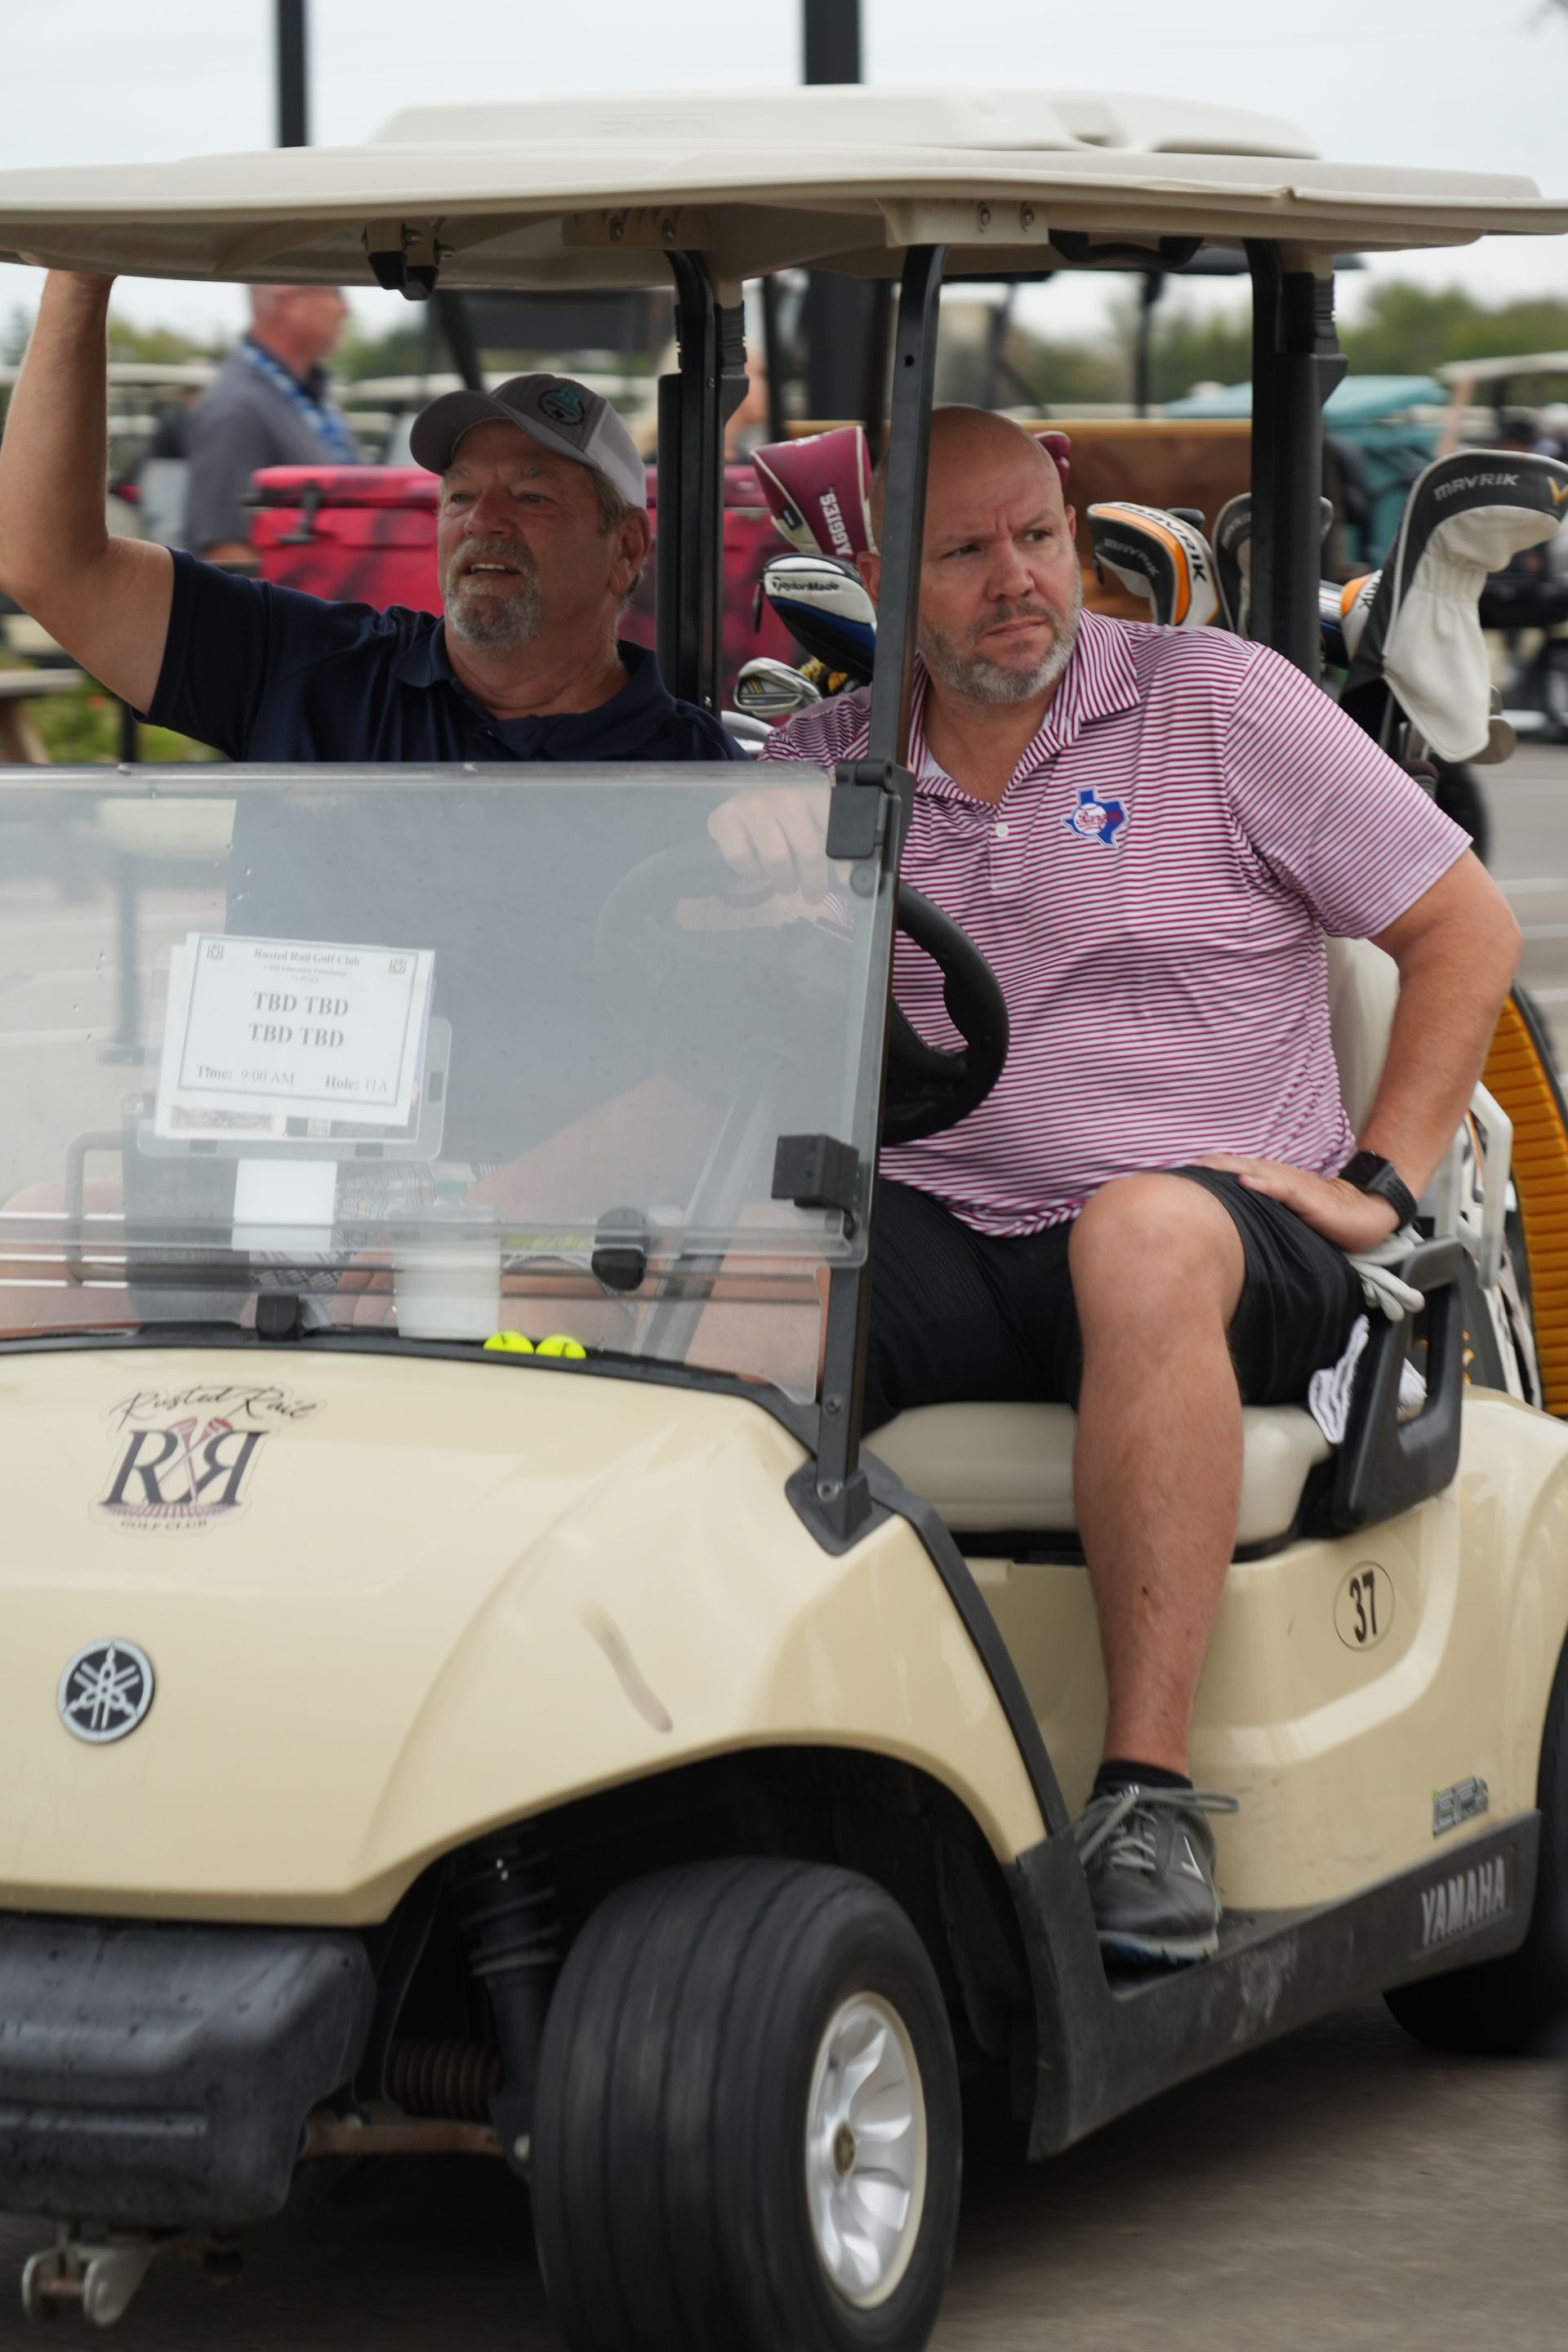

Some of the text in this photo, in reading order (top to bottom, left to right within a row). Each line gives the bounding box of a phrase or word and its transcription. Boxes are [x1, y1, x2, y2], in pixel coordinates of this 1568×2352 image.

[1433, 473, 1521, 501] MAVRIK
[820, 492, 853, 556] AGGIES
[772, 577, 840, 591] TaylorMade
[253, 991, 349, 1016] TBD TBD
[248, 1022, 345, 1047] TBD TBD
[197, 1064, 295, 1085] Time: 9:00 AM
[326, 1074, 359, 1090] Hole:
[1349, 1569, 1379, 1644] 37
[1421, 1855, 1506, 1946] YAMAHA
